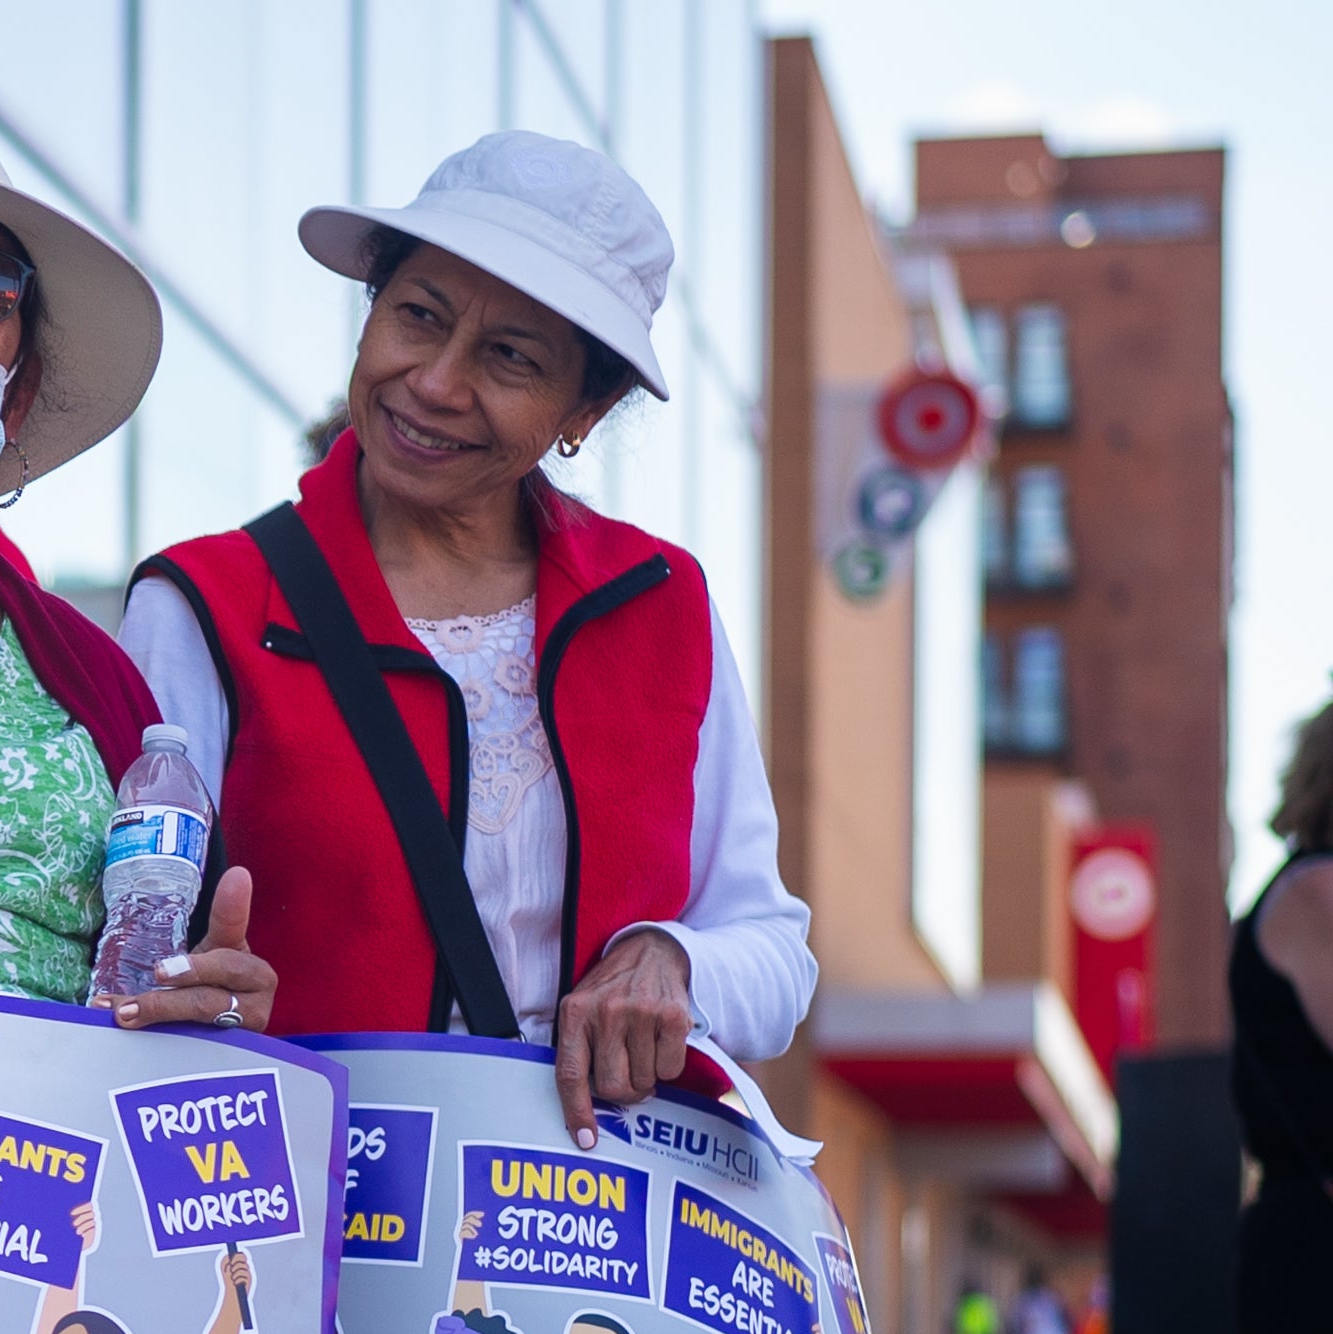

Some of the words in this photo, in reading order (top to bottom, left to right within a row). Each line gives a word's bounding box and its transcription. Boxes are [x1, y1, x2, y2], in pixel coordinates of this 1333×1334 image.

[137, 1090, 268, 1143] PROTECT
[185, 1141, 249, 1183] VA
[491, 1159, 625, 1211] UNION
[157, 1184, 289, 1236] WORKERS
[497, 1205, 619, 1251] STRONG
[473, 1245, 639, 1286] #SOLIDARITY
[680, 1199, 814, 1302] IMMIGRANTS
[731, 1260, 775, 1308] ARE
